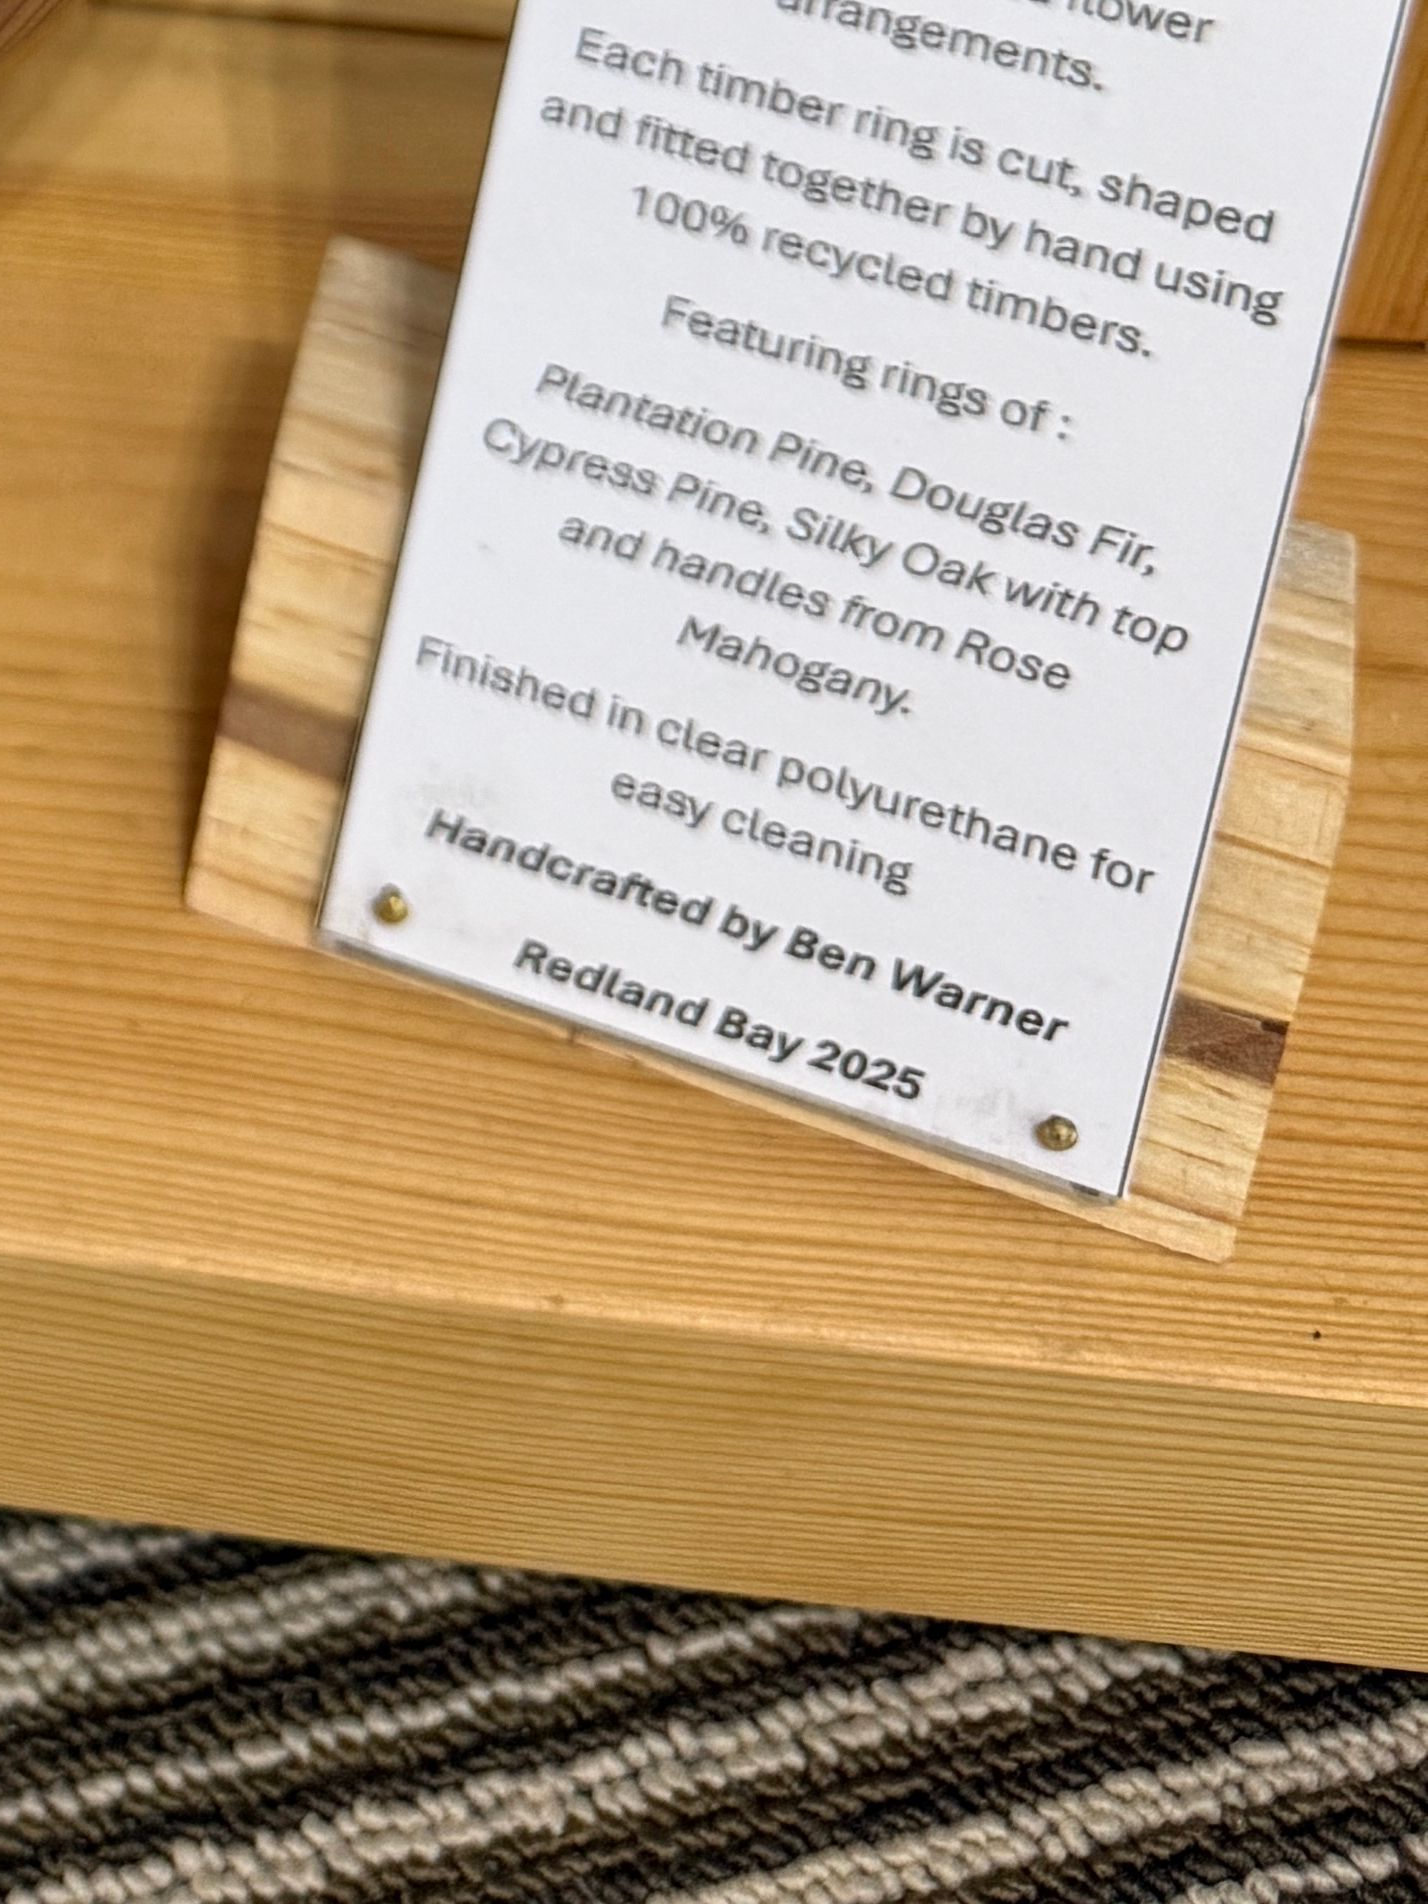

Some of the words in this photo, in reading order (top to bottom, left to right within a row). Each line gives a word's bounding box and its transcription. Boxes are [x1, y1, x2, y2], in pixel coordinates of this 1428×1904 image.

[540, 96, 624, 140] and
[636, 115, 751, 175] fitted
[763, 152, 951, 227] together
[960, 202, 1015, 250] by
[1024, 220, 1142, 281] hand
[1154, 262, 1284, 327] using
[575, 27, 684, 85] Each
[698, 63, 844, 127] timber
[853, 109, 938, 161] ring
[949, 126, 985, 166] is
[997, 148, 1082, 197] cut,
[1097, 173, 1275, 244] shaped
[634, 186, 749, 245] 100%
[762, 228, 955, 302] recycled
[967, 278, 1150, 357] timbers.
[661, 295, 871, 391] Featuring
[880, 361, 987, 417] rings
[999, 399, 1050, 431] of
[483, 418, 657, 496] Cypress
[666, 473, 769, 535] Pine,
[785, 507, 893, 569] Silky
[901, 542, 996, 596] Oak
[1005, 577, 1100, 626] with
[1111, 606, 1189, 656] top
[536, 364, 759, 454] Plantation
[768, 431, 873, 494] Pine,
[889, 466, 1080, 548] Douglas
[1088, 524, 1154, 576] Fir,
[558, 517, 645, 562] and
[651, 538, 830, 618] handles
[839, 594, 945, 652] from
[954, 628, 1071, 690] Rose
[676, 616, 910, 716] Mahogany.
[416, 636, 597, 721] Finished
[607, 701, 644, 735] in
[656, 718, 769, 771] clear
[776, 756, 1077, 871] polyurethane
[1090, 847, 1155, 894] for
[611, 773, 713, 829] easy
[721, 808, 912, 897] cleaning
[425, 809, 714, 928] Handcrafted
[717, 904, 779, 953] by
[783, 926, 877, 981] Ben
[891, 958, 1069, 1041] Warner
[513, 939, 710, 1029] Redland
[713, 1006, 805, 1064] Bay
[806, 1039, 925, 1100] 2025
